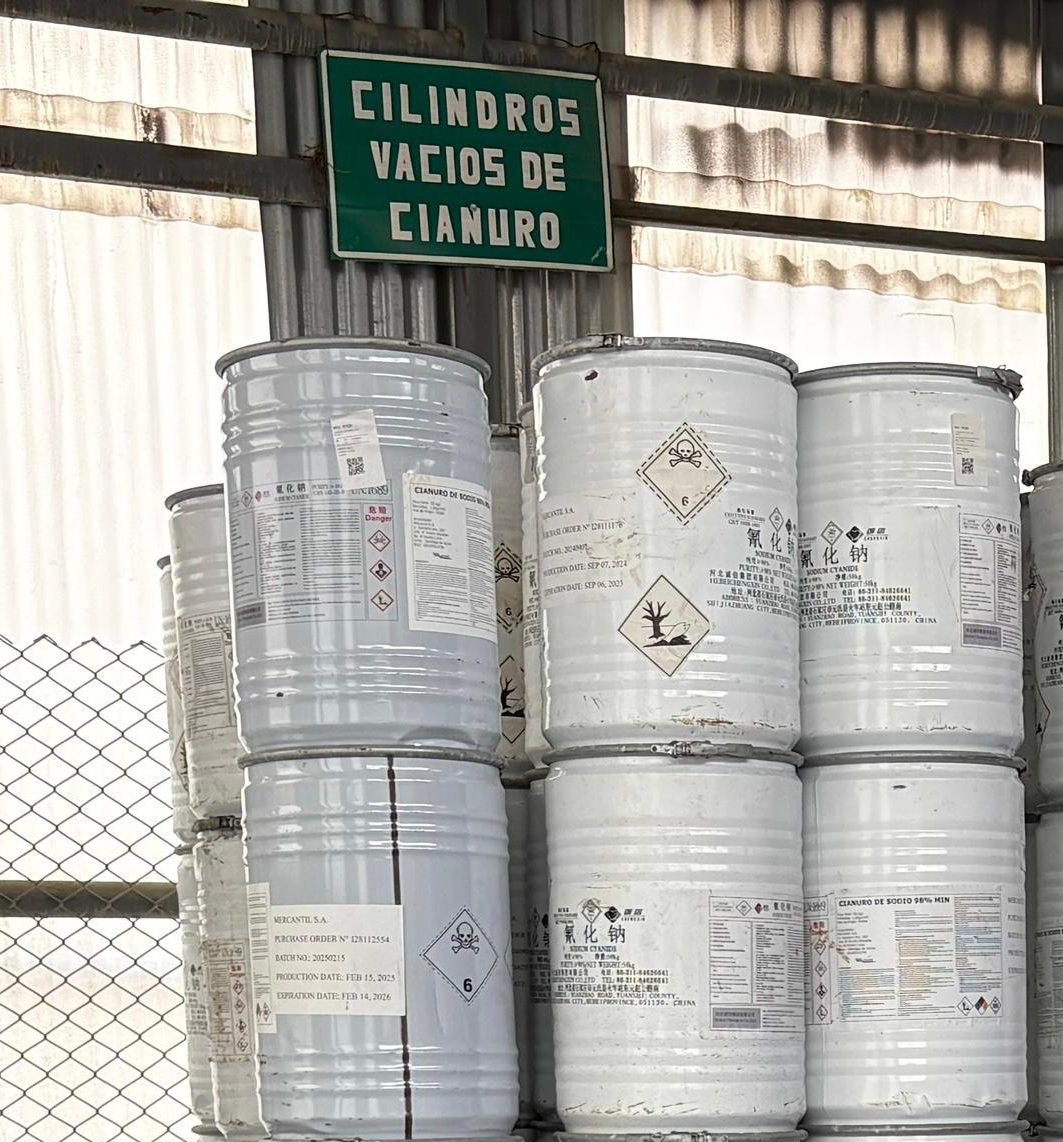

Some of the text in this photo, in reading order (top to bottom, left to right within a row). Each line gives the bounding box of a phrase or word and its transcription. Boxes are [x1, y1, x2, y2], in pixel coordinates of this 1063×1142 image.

[351, 80, 581, 137] CILINDROS
[370, 141, 566, 191] VACIOS DE
[276, 482, 307, 494] 氰化钠
[414, 487, 458, 499] CIANURO DE
[682, 497, 689, 506] 6
[365, 514, 393, 523] Danger
[587, 561, 601, 569] SEP
[612, 560, 628, 568] 2024
[830, 565, 858, 573] CYANIDE
[585, 581, 598, 589] SEP
[505, 607, 512, 617] 6
[839, 899, 872, 907] CIANURO
[887, 897, 912, 905] SODIO
[313, 916, 327, 924] S.A.
[310, 935, 337, 944] ORDER
[320, 973, 344, 981] DATE:
[346, 973, 362, 981] FEB
[365, 973, 376, 982] 15,
[377, 973, 395, 982] 2025
[463, 978, 472, 993] 6
[317, 992, 340, 1000] DATE:
[342, 992, 358, 1000] FEB
[360, 992, 371, 1002] 14,
[374, 993, 391, 1001] 2026
